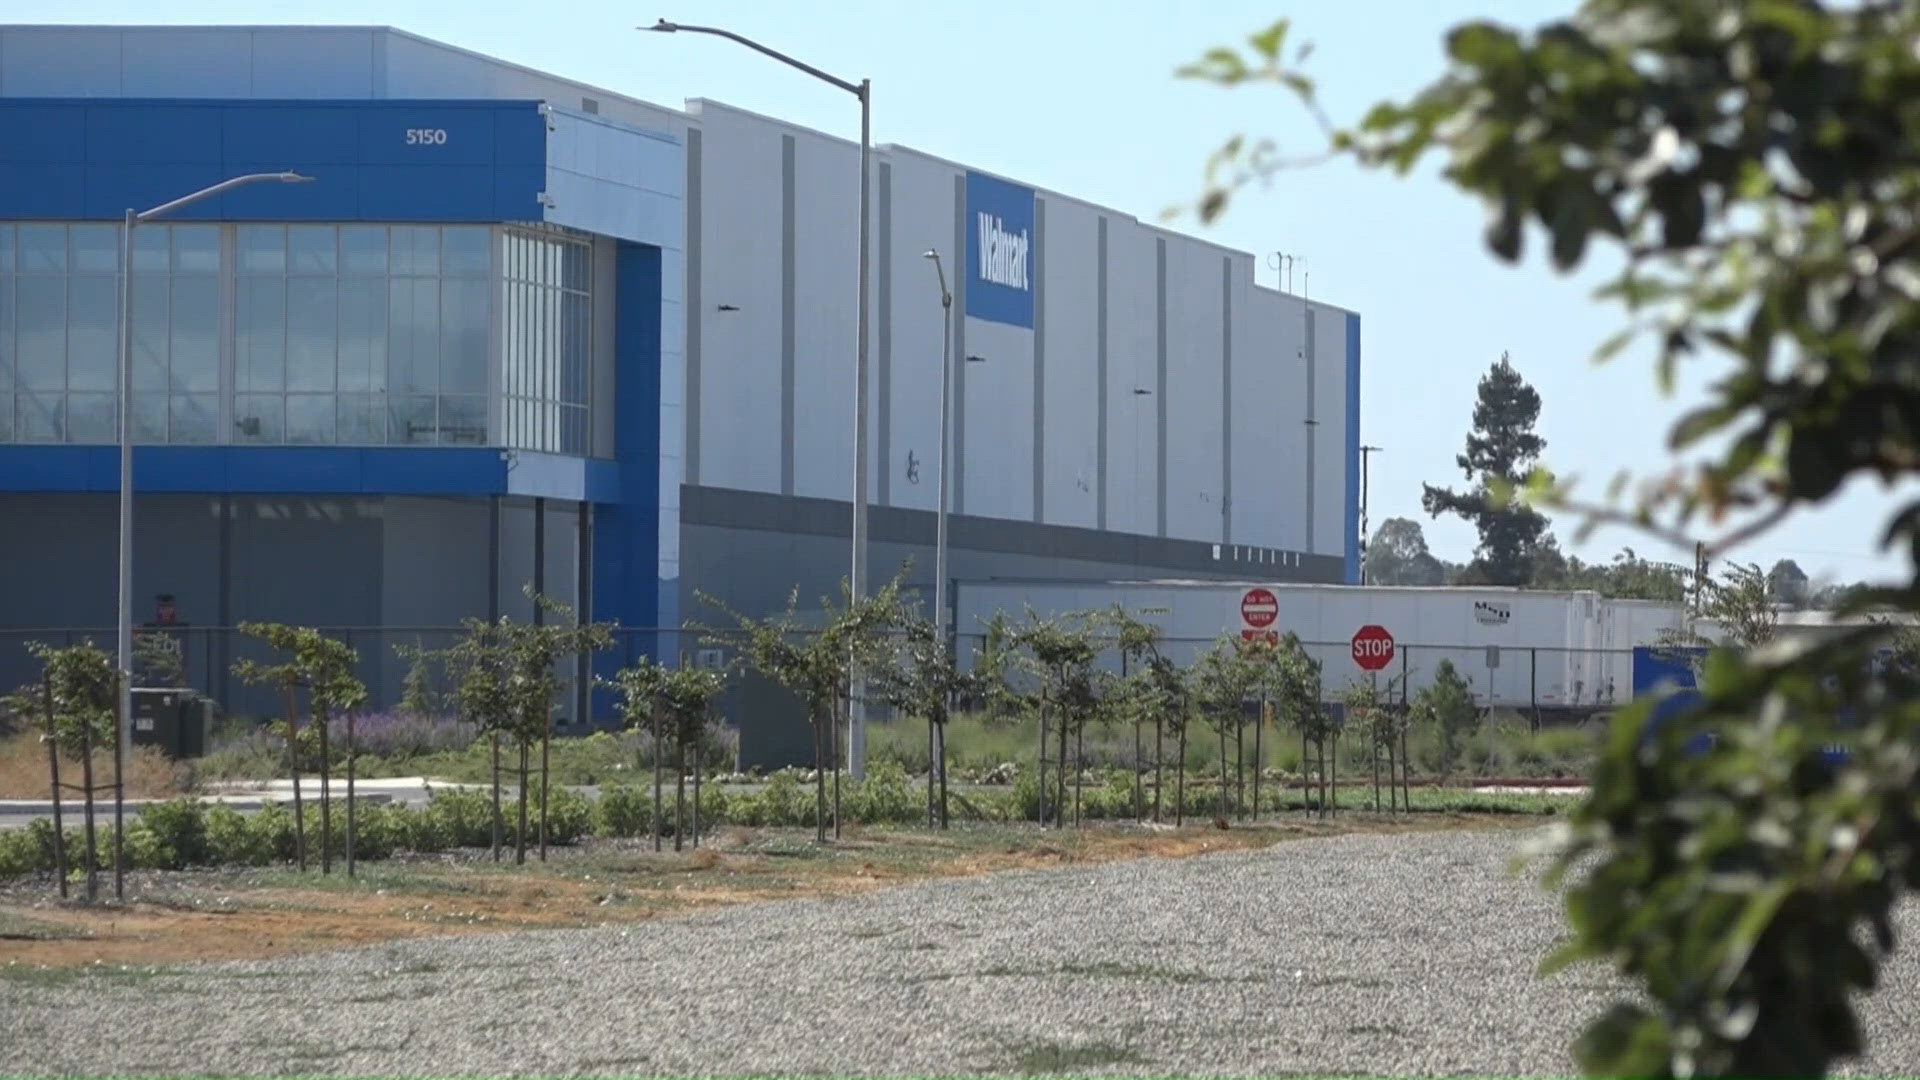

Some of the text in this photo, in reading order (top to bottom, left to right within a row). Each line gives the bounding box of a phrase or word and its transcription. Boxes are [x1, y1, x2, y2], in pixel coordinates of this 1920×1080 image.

[406, 129, 447, 145] 5150
[978, 211, 1028, 291] Walmart
[1354, 639, 1392, 656] STOP
